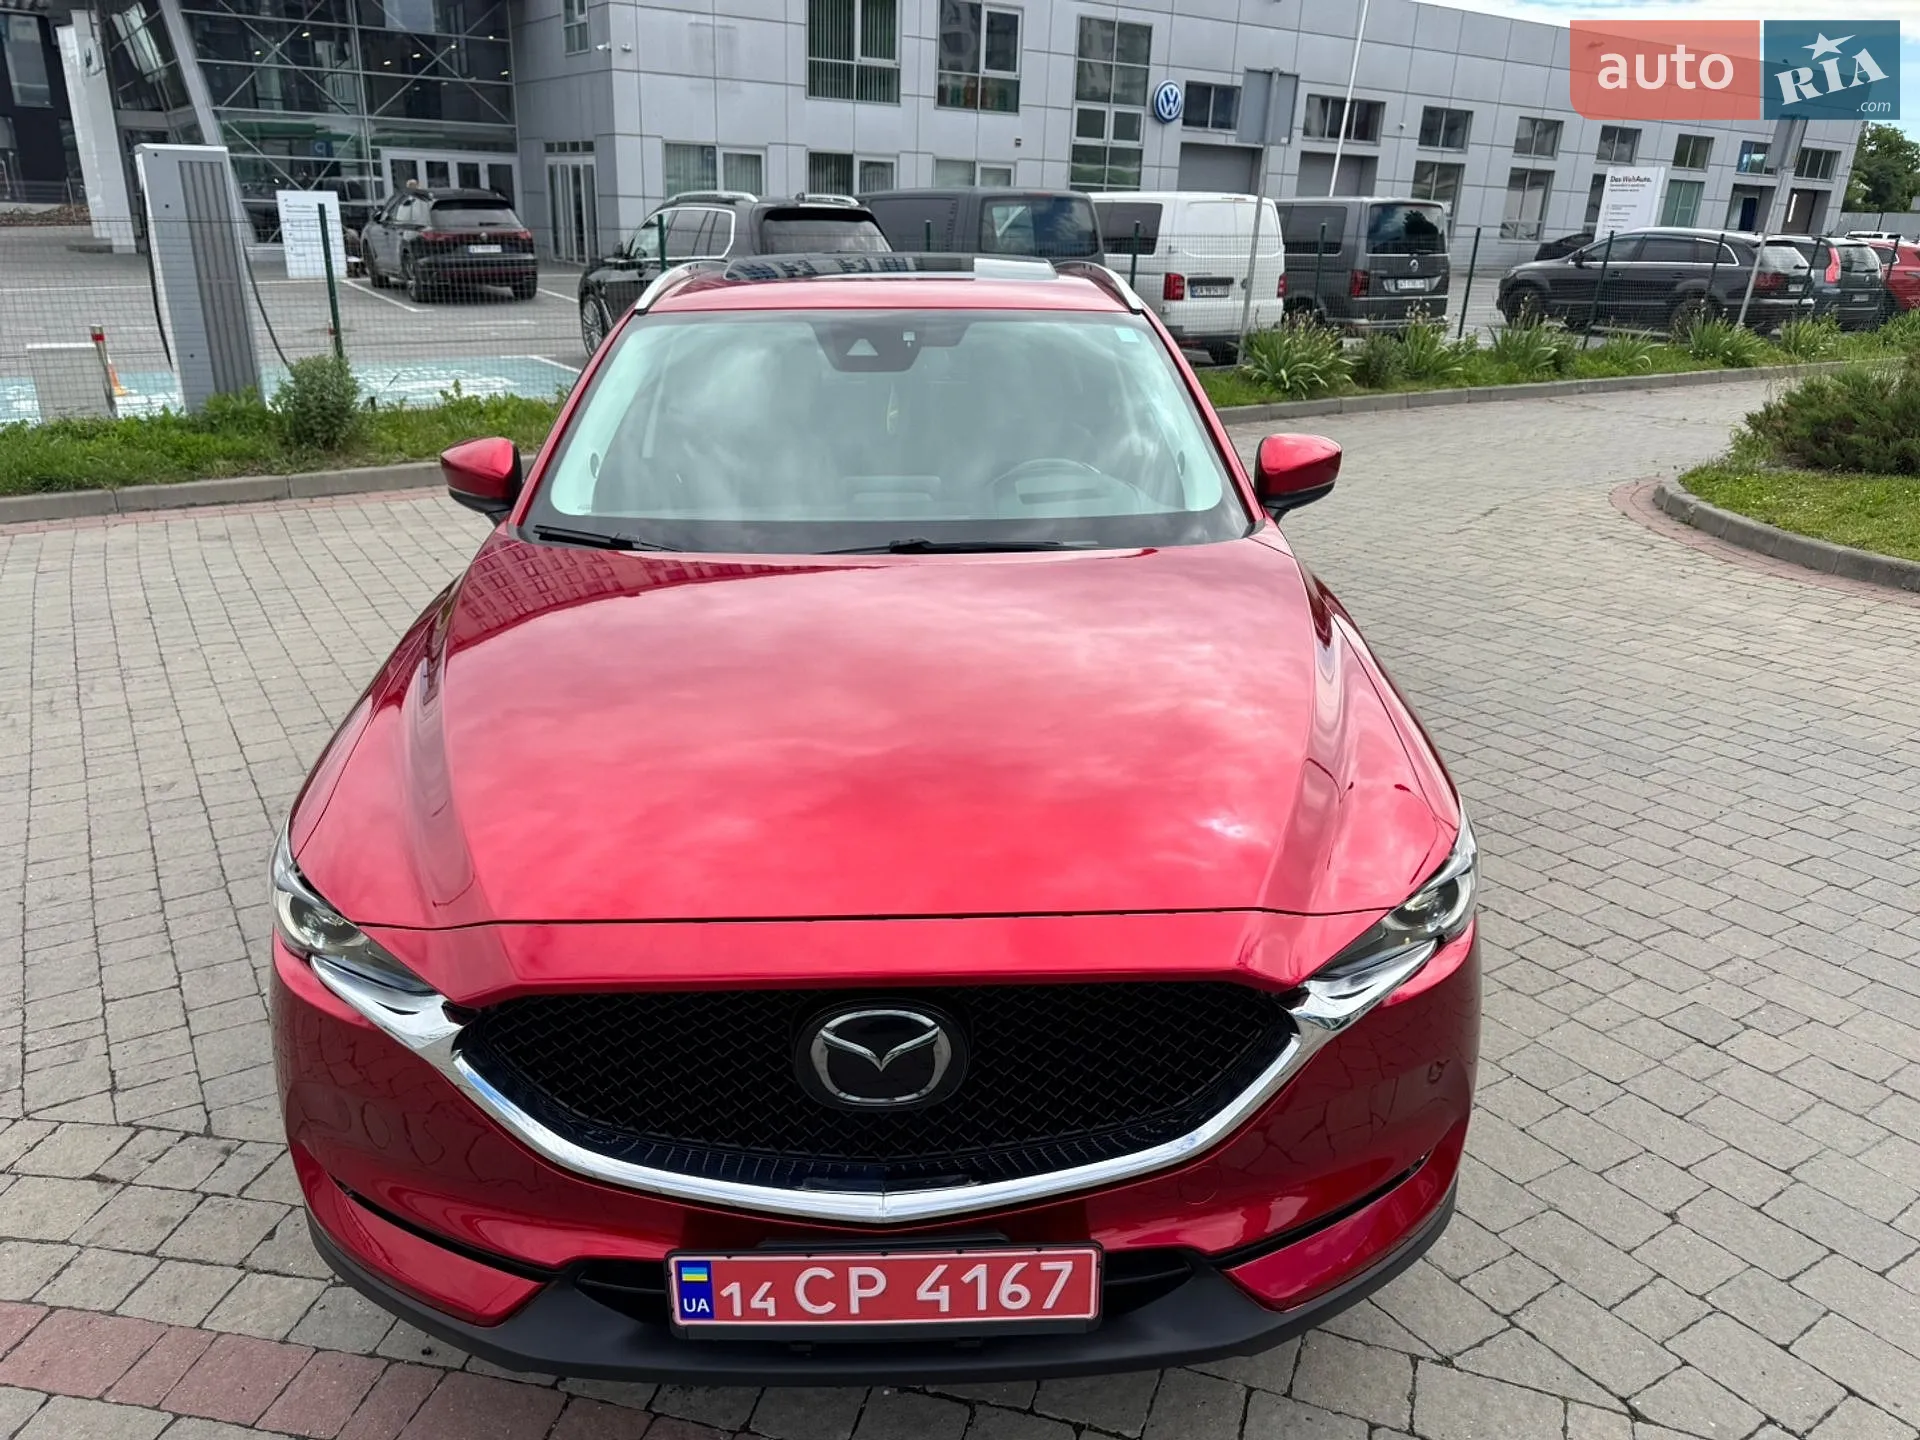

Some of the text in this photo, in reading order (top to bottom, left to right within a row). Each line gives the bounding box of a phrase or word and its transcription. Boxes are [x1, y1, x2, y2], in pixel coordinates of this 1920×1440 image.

[683, 1298, 710, 1313] UA
[720, 1261, 1073, 1317] 14 CP 4167
